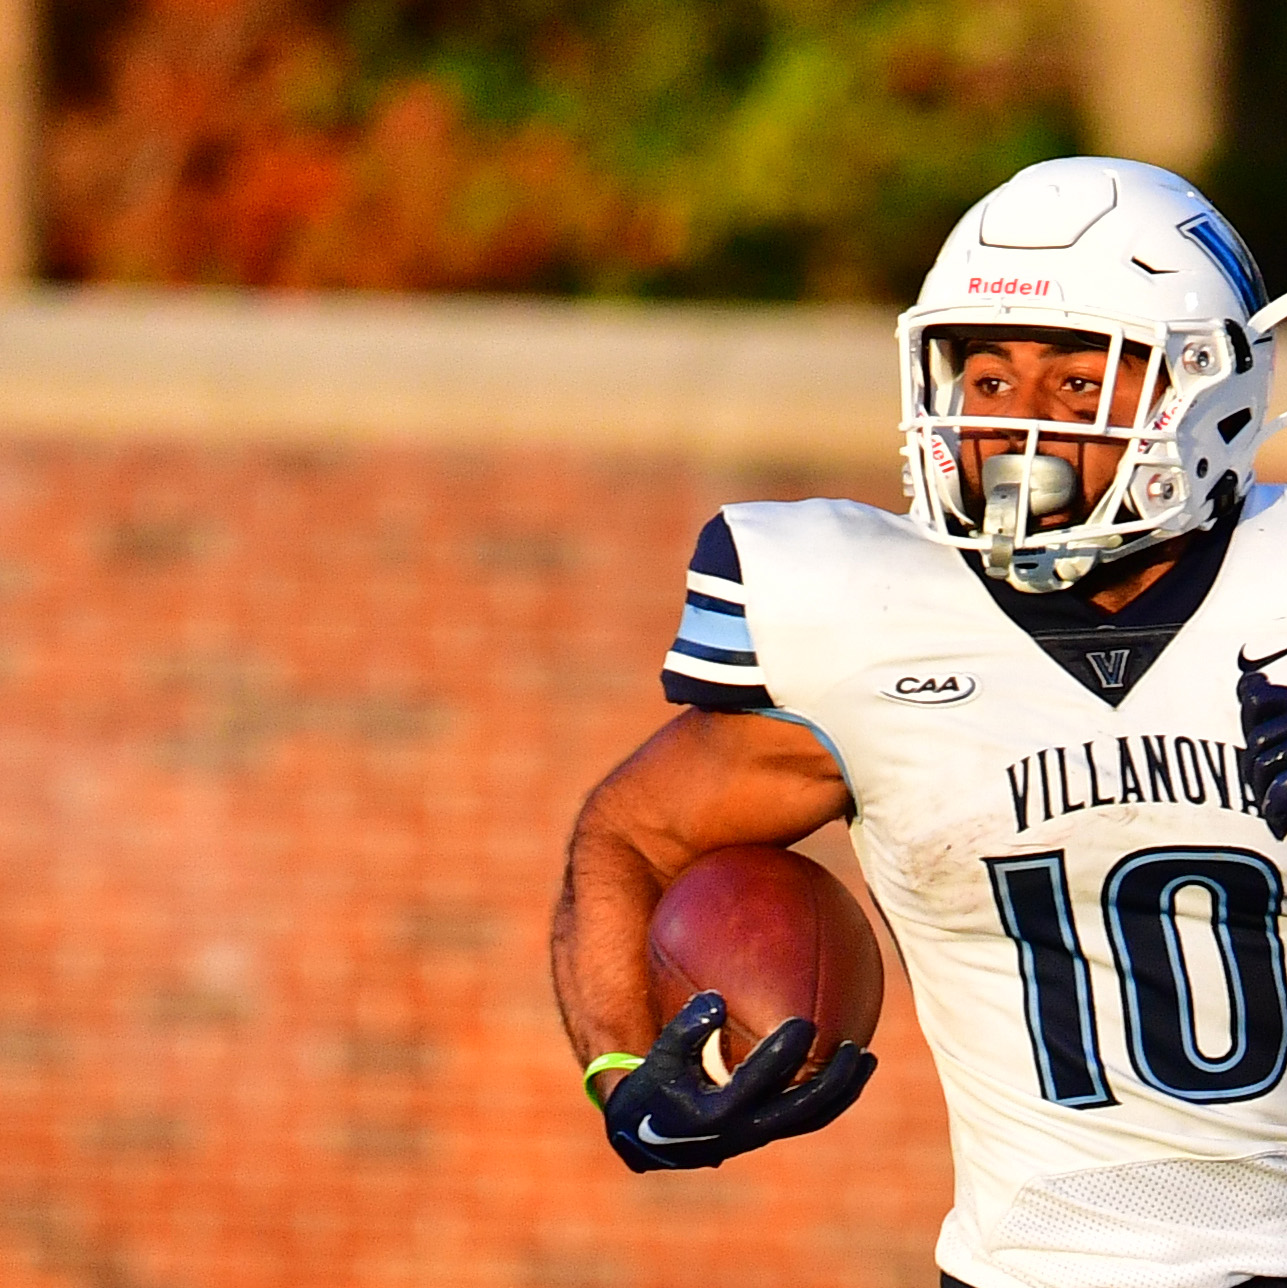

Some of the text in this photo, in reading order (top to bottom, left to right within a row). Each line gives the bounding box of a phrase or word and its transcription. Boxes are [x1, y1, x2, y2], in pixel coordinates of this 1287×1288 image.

[968, 277, 1051, 296] Riddell
[1086, 649, 1130, 689] V
[895, 676, 960, 695] CAA
